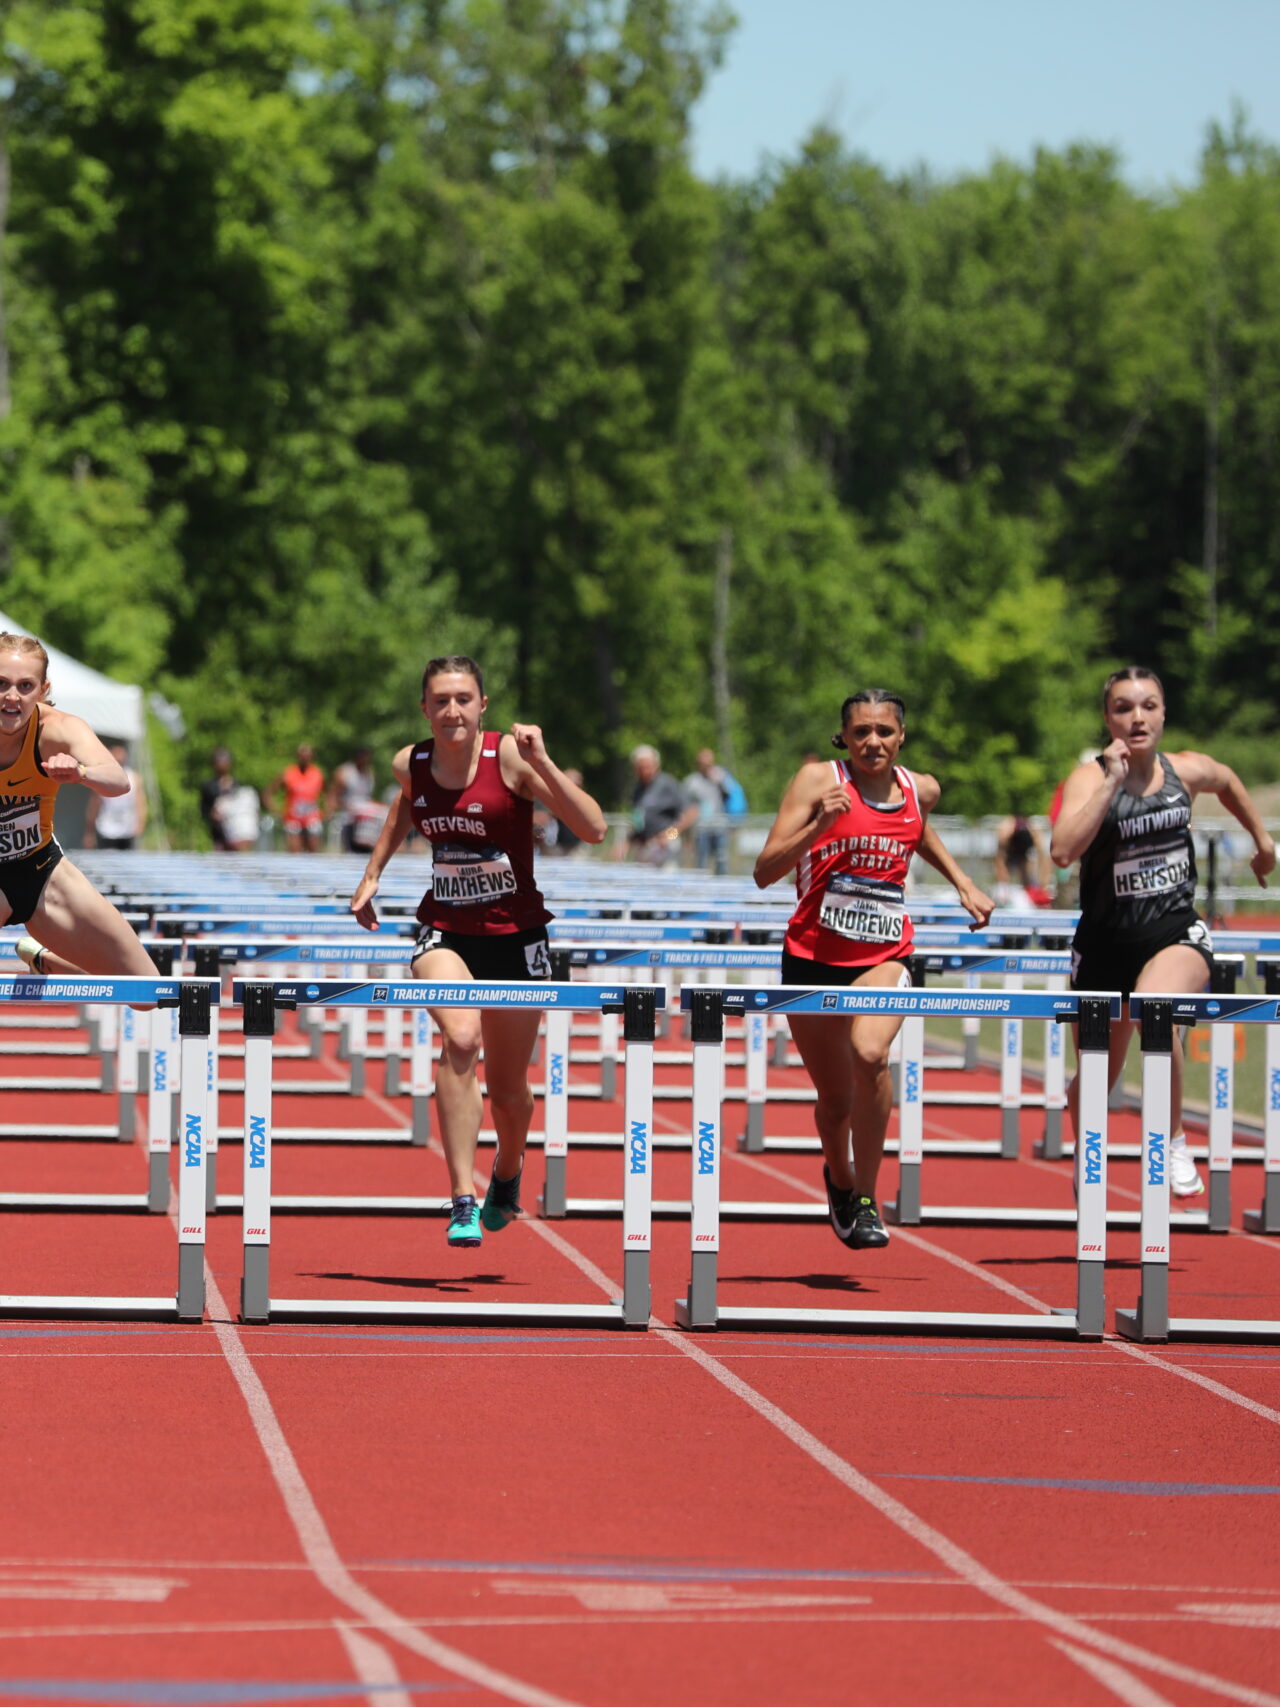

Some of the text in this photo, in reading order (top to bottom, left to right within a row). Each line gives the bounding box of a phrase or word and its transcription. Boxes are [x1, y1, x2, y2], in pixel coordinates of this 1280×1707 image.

[421, 816, 487, 837] STEVENS
[1118, 806, 1190, 840] WHITWORTH
[850, 853, 893, 869] STATE
[436, 870, 515, 899] MATHEWS
[1116, 861, 1190, 893] HEWSON
[821, 906, 902, 937] ANDREWS
[315, 948, 343, 959] TRACK
[350, 949, 373, 959] FIELD
[533, 945, 548, 975] 4
[665, 952, 692, 963] TRACK
[698, 953, 724, 964] FIELD
[1021, 959, 1048, 970] TRACK
[27, 985, 113, 996] CHAMPIONSHIPS
[394, 989, 558, 1001] TRACK & FIELD CHAMPIONSHIPS
[843, 996, 1010, 1010] TRACK & FIELD CHAMPIONSHIPS
[1053, 1001, 1072, 1009] GILL
[155, 1051, 166, 1091] NCAA
[551, 1054, 562, 1094] NCAA
[906, 1062, 918, 1102] NCAA
[1216, 1068, 1228, 1108] NCAA
[186, 1114, 201, 1166] NCAA
[250, 1116, 265, 1168] NCAA
[631, 1121, 646, 1173] NCAA
[699, 1122, 714, 1174] NCAA
[1085, 1131, 1101, 1183] NCAA
[1149, 1132, 1164, 1185] NCAA
[1082, 1244, 1102, 1252] GILL
[1145, 1245, 1166, 1253] GILL
